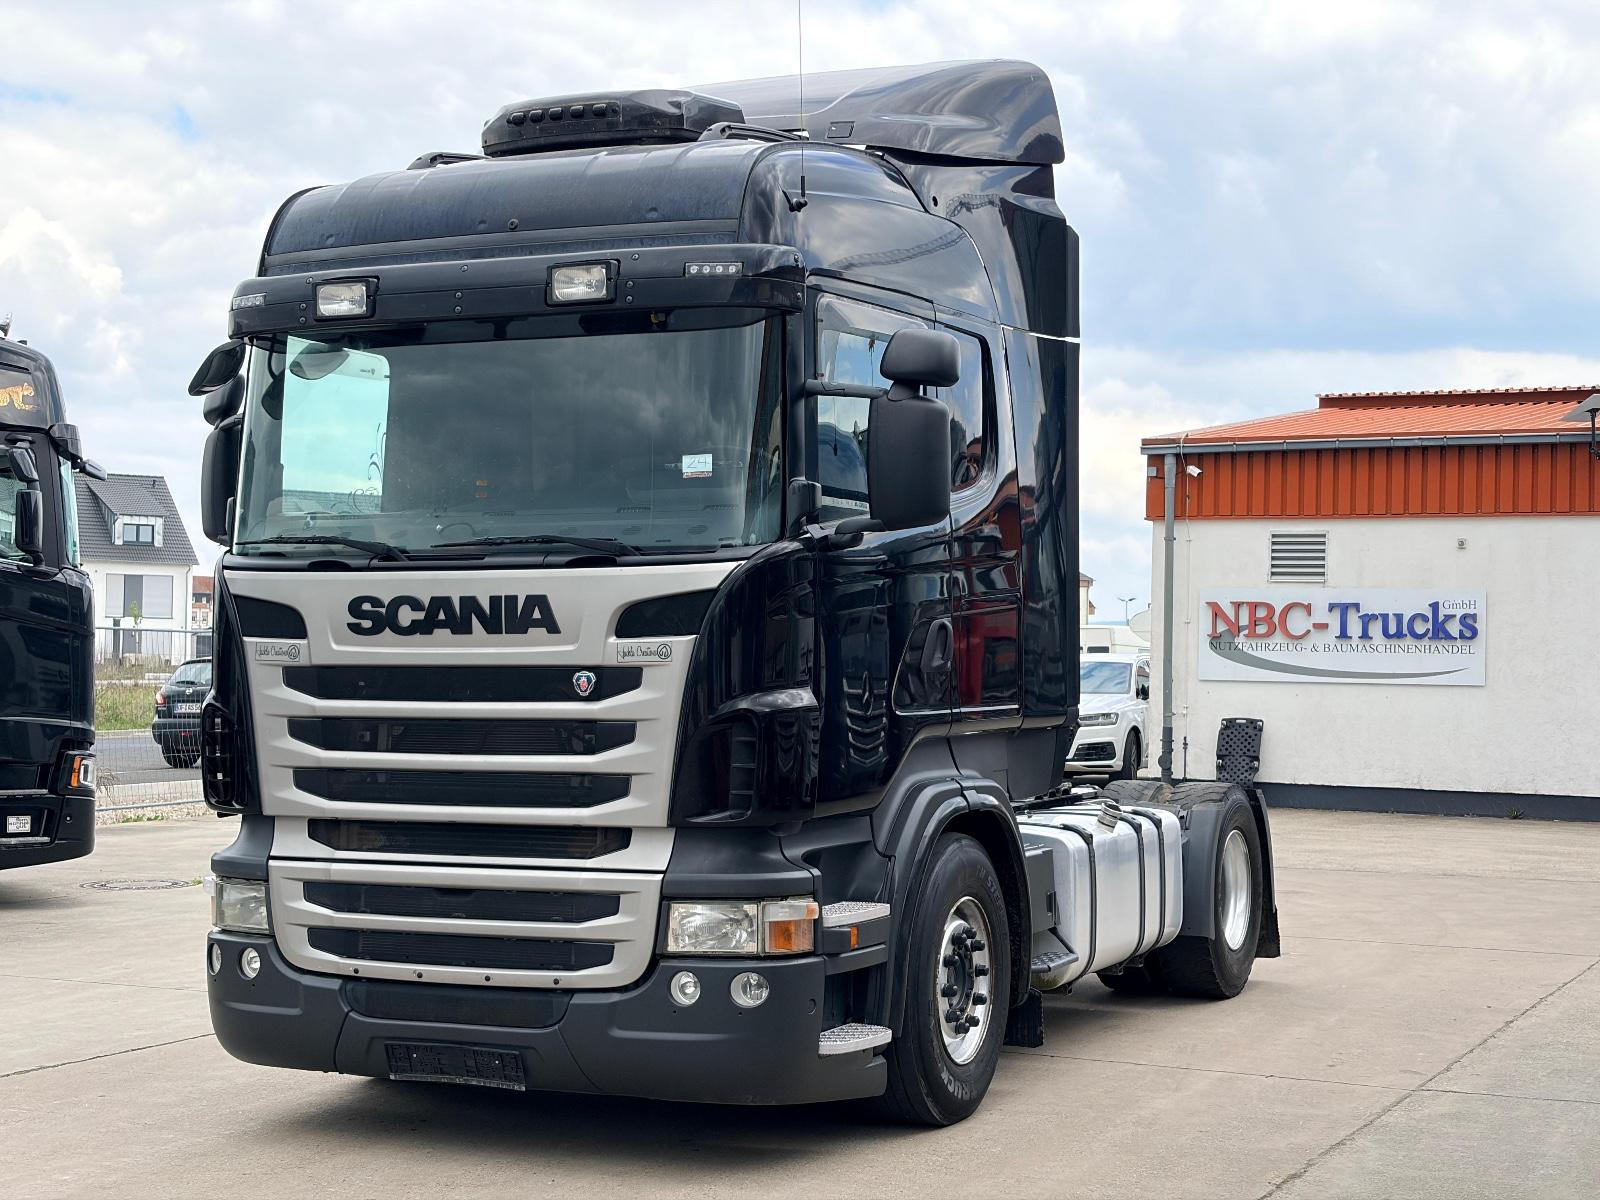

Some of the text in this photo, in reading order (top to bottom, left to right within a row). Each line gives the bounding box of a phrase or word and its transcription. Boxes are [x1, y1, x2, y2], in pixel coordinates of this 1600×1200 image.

[347, 594, 561, 636] SCANIA
[1442, 599, 1477, 610] GmbH
[1205, 601, 1479, 641] NBC-Trucks
[1210, 641, 1476, 655] NUTZFAHRZEUG- & BAUMASCHINENHANDEL
